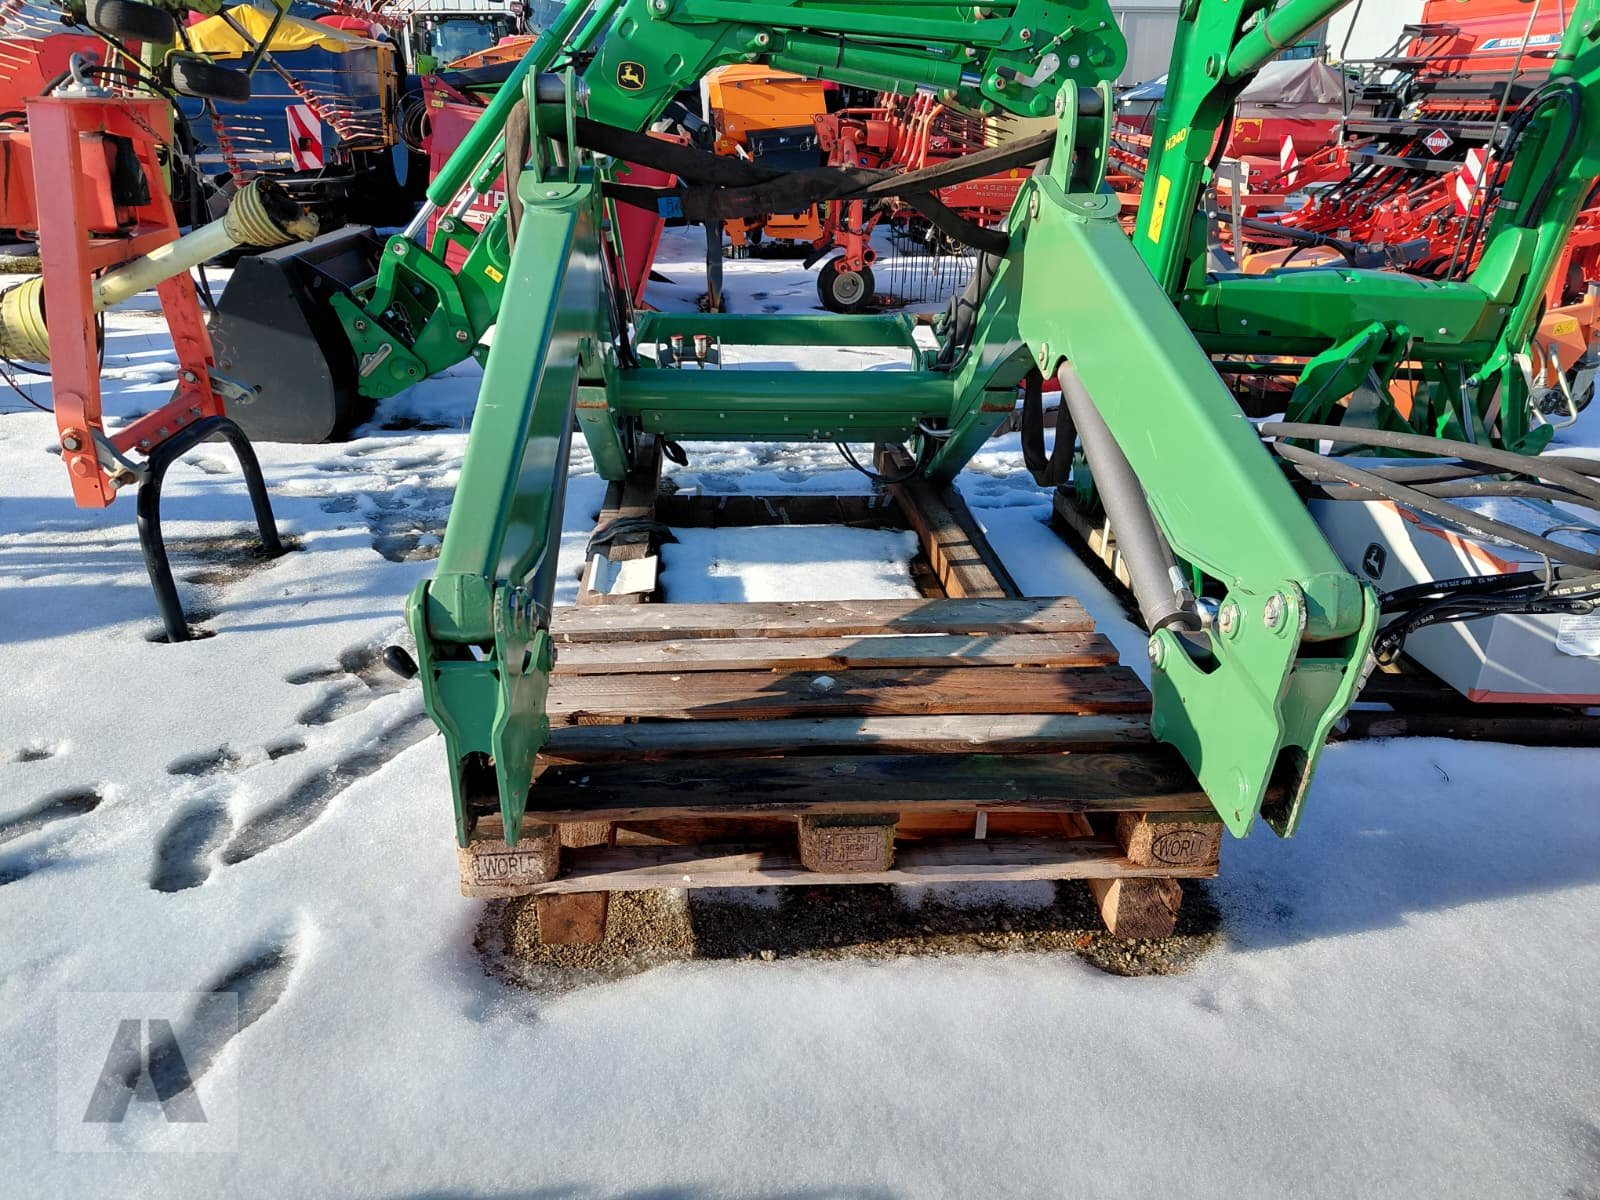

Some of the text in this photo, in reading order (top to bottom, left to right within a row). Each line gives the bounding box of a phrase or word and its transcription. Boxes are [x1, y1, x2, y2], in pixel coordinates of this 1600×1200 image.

[1165, 127, 1187, 152] H240
[1427, 137, 1449, 147] KUHN
[1421, 614, 1435, 624] BAR
